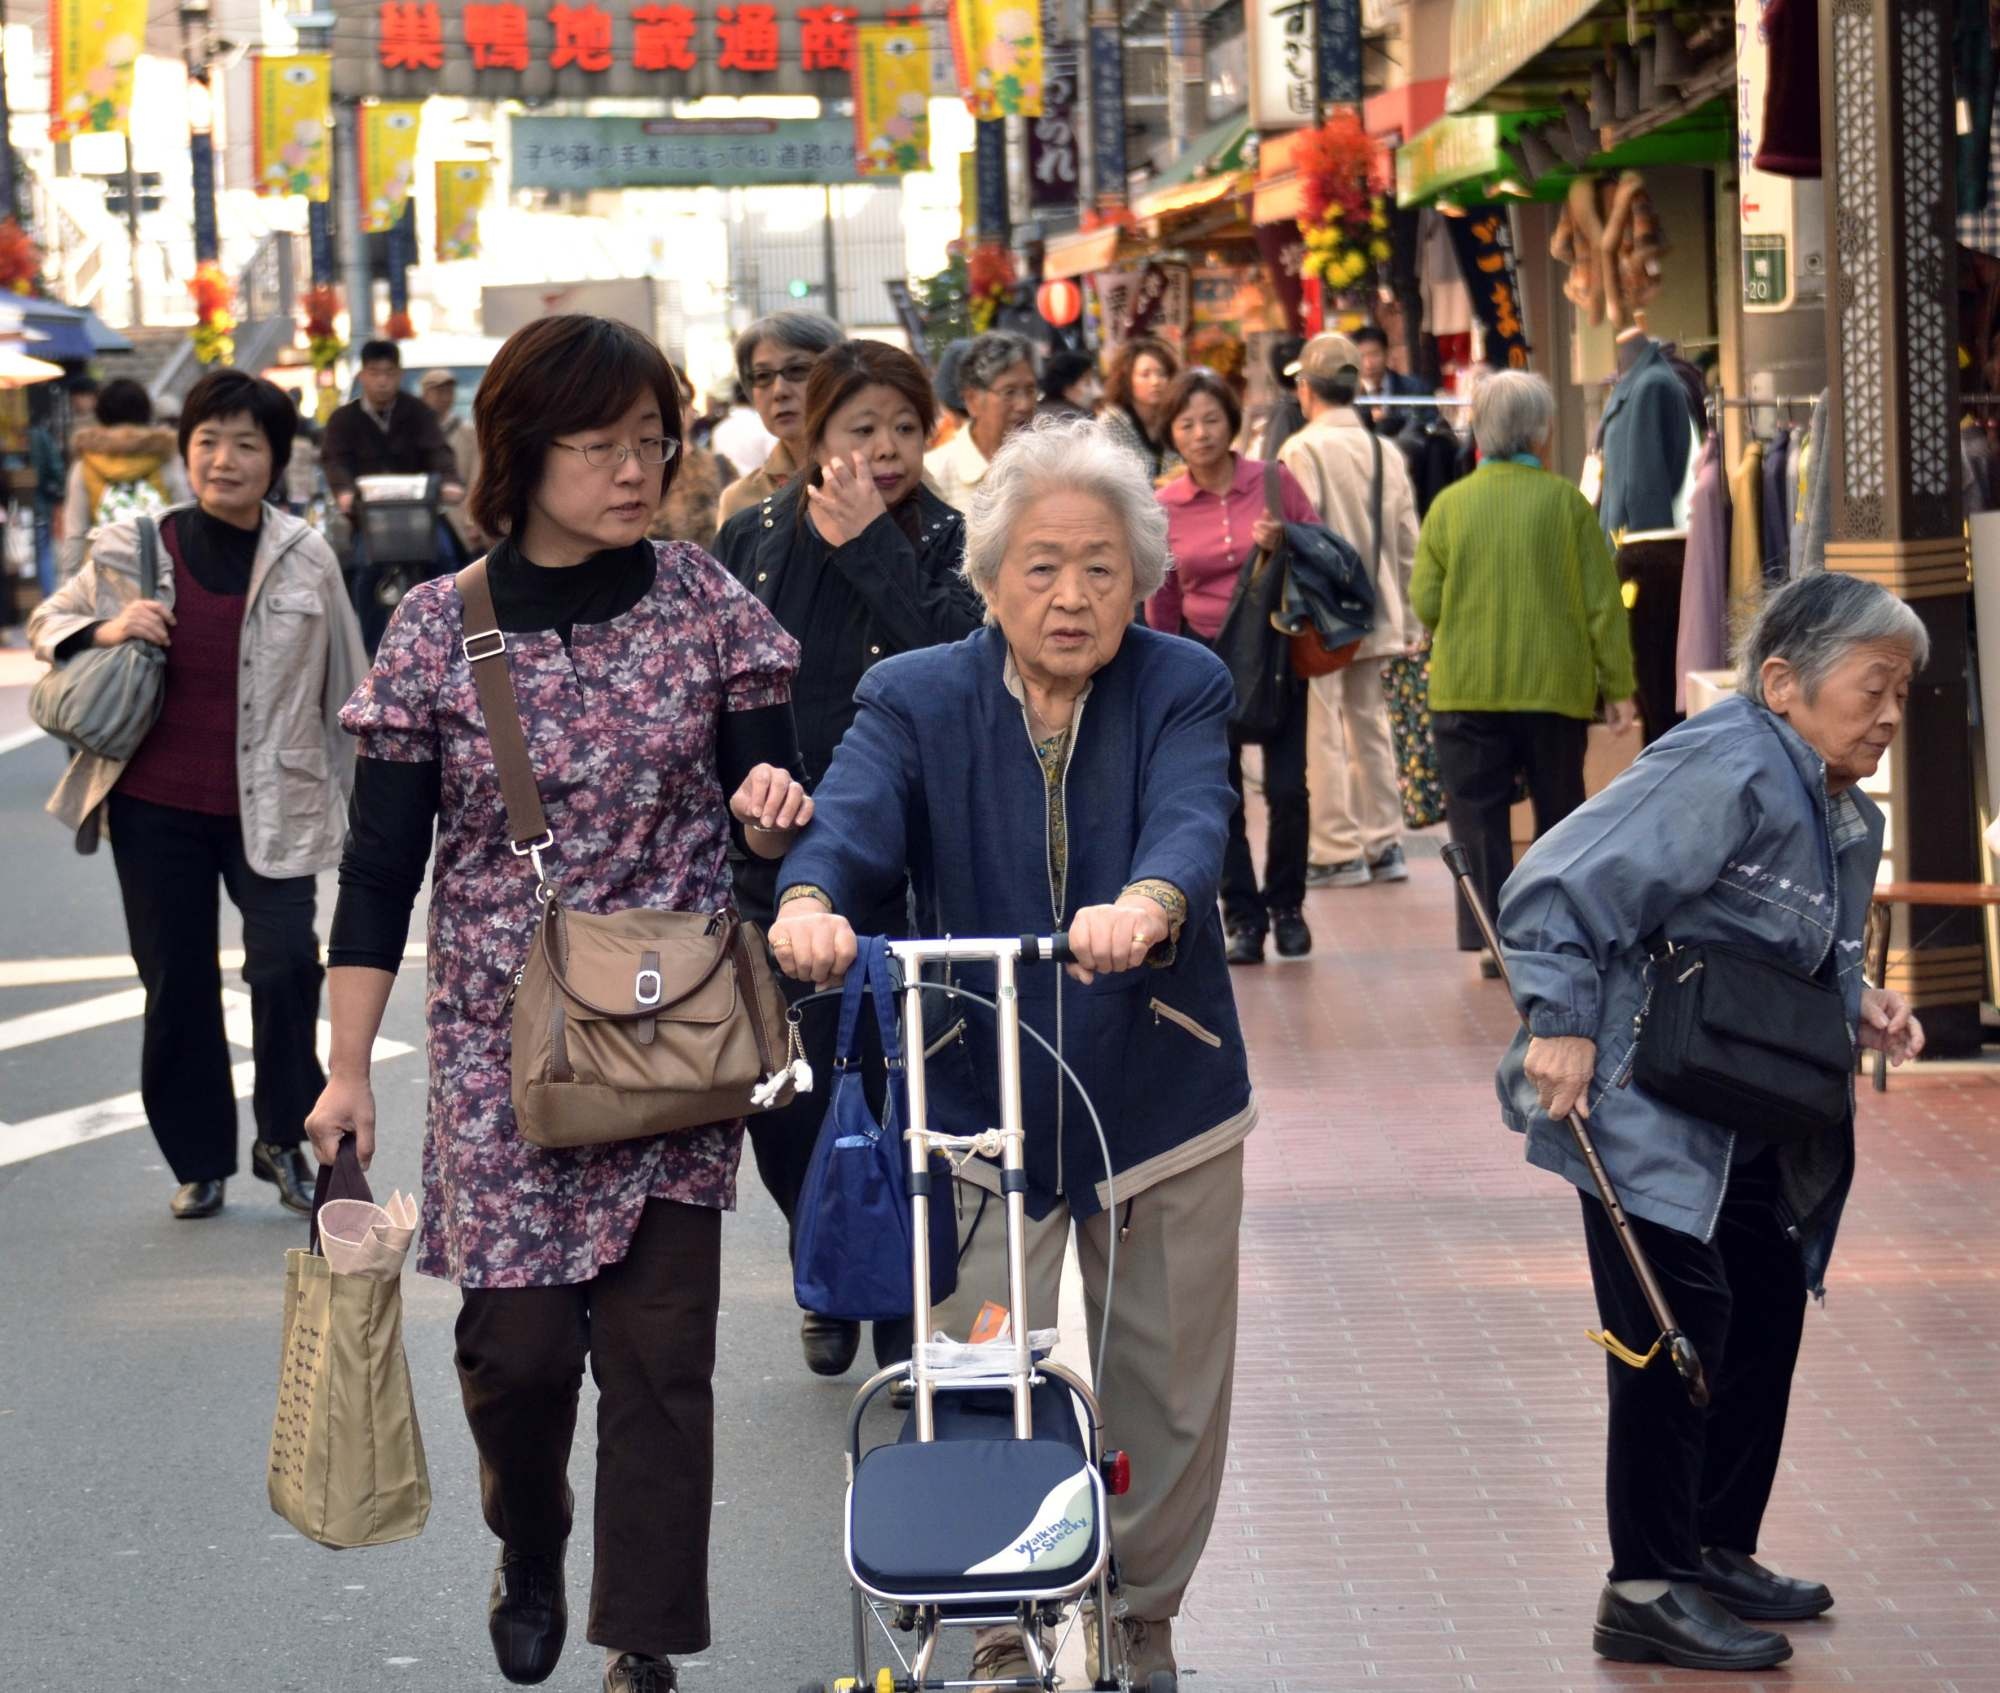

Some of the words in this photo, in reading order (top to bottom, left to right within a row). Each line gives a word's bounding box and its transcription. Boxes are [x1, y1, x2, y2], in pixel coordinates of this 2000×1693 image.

[379, 1, 922, 72] 巣鴨地蔵通商
[1014, 1518, 1072, 1564] Walking
[1042, 1517, 1088, 1552] Stecky
